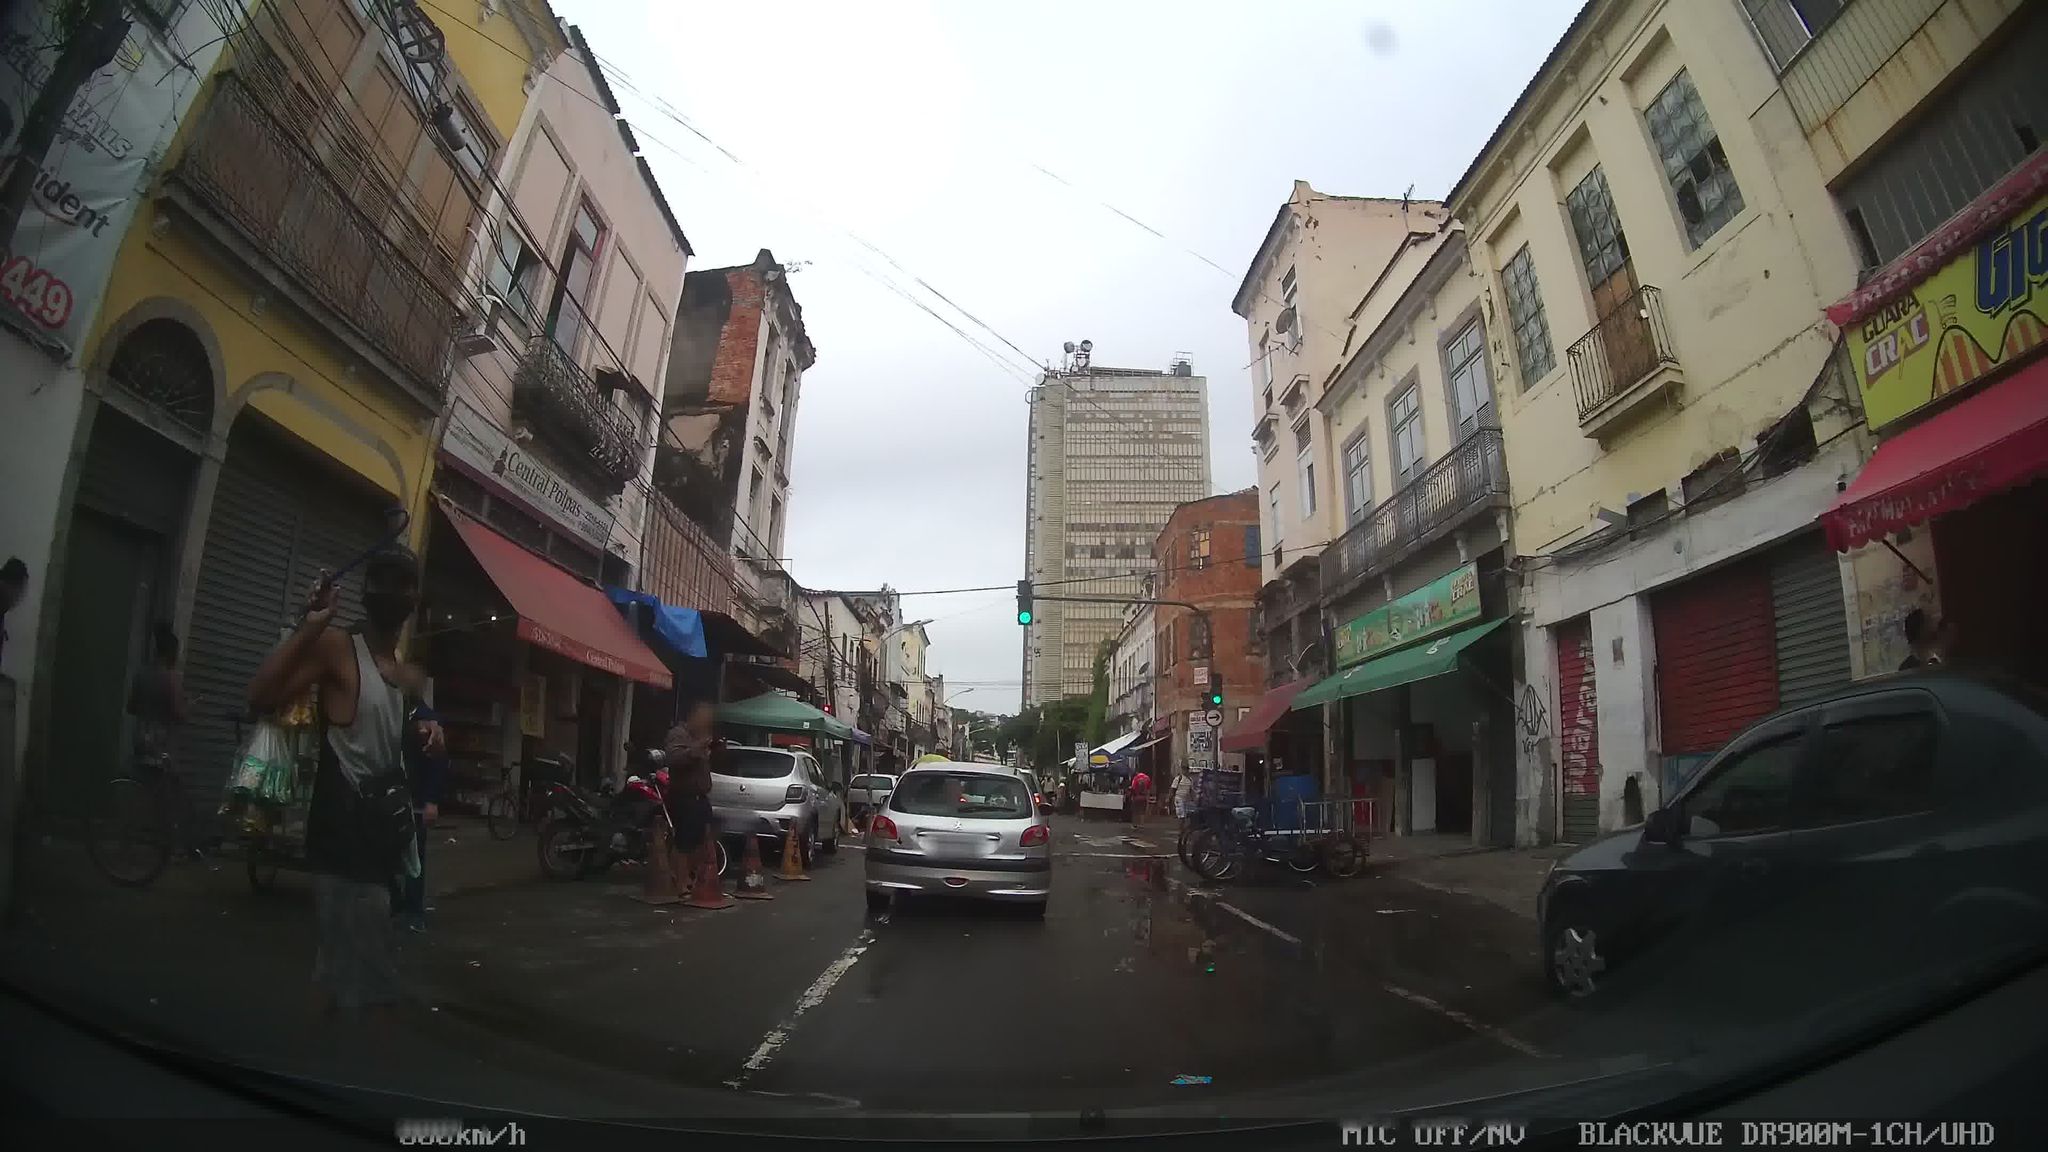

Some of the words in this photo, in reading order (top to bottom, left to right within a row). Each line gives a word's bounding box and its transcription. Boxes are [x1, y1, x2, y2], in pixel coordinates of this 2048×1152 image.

[33, 168, 110, 239] ident
[1864, 312, 1930, 378] CRAC
[507, 452, 551, 495] Central
[547, 481, 582, 516] Polpas
